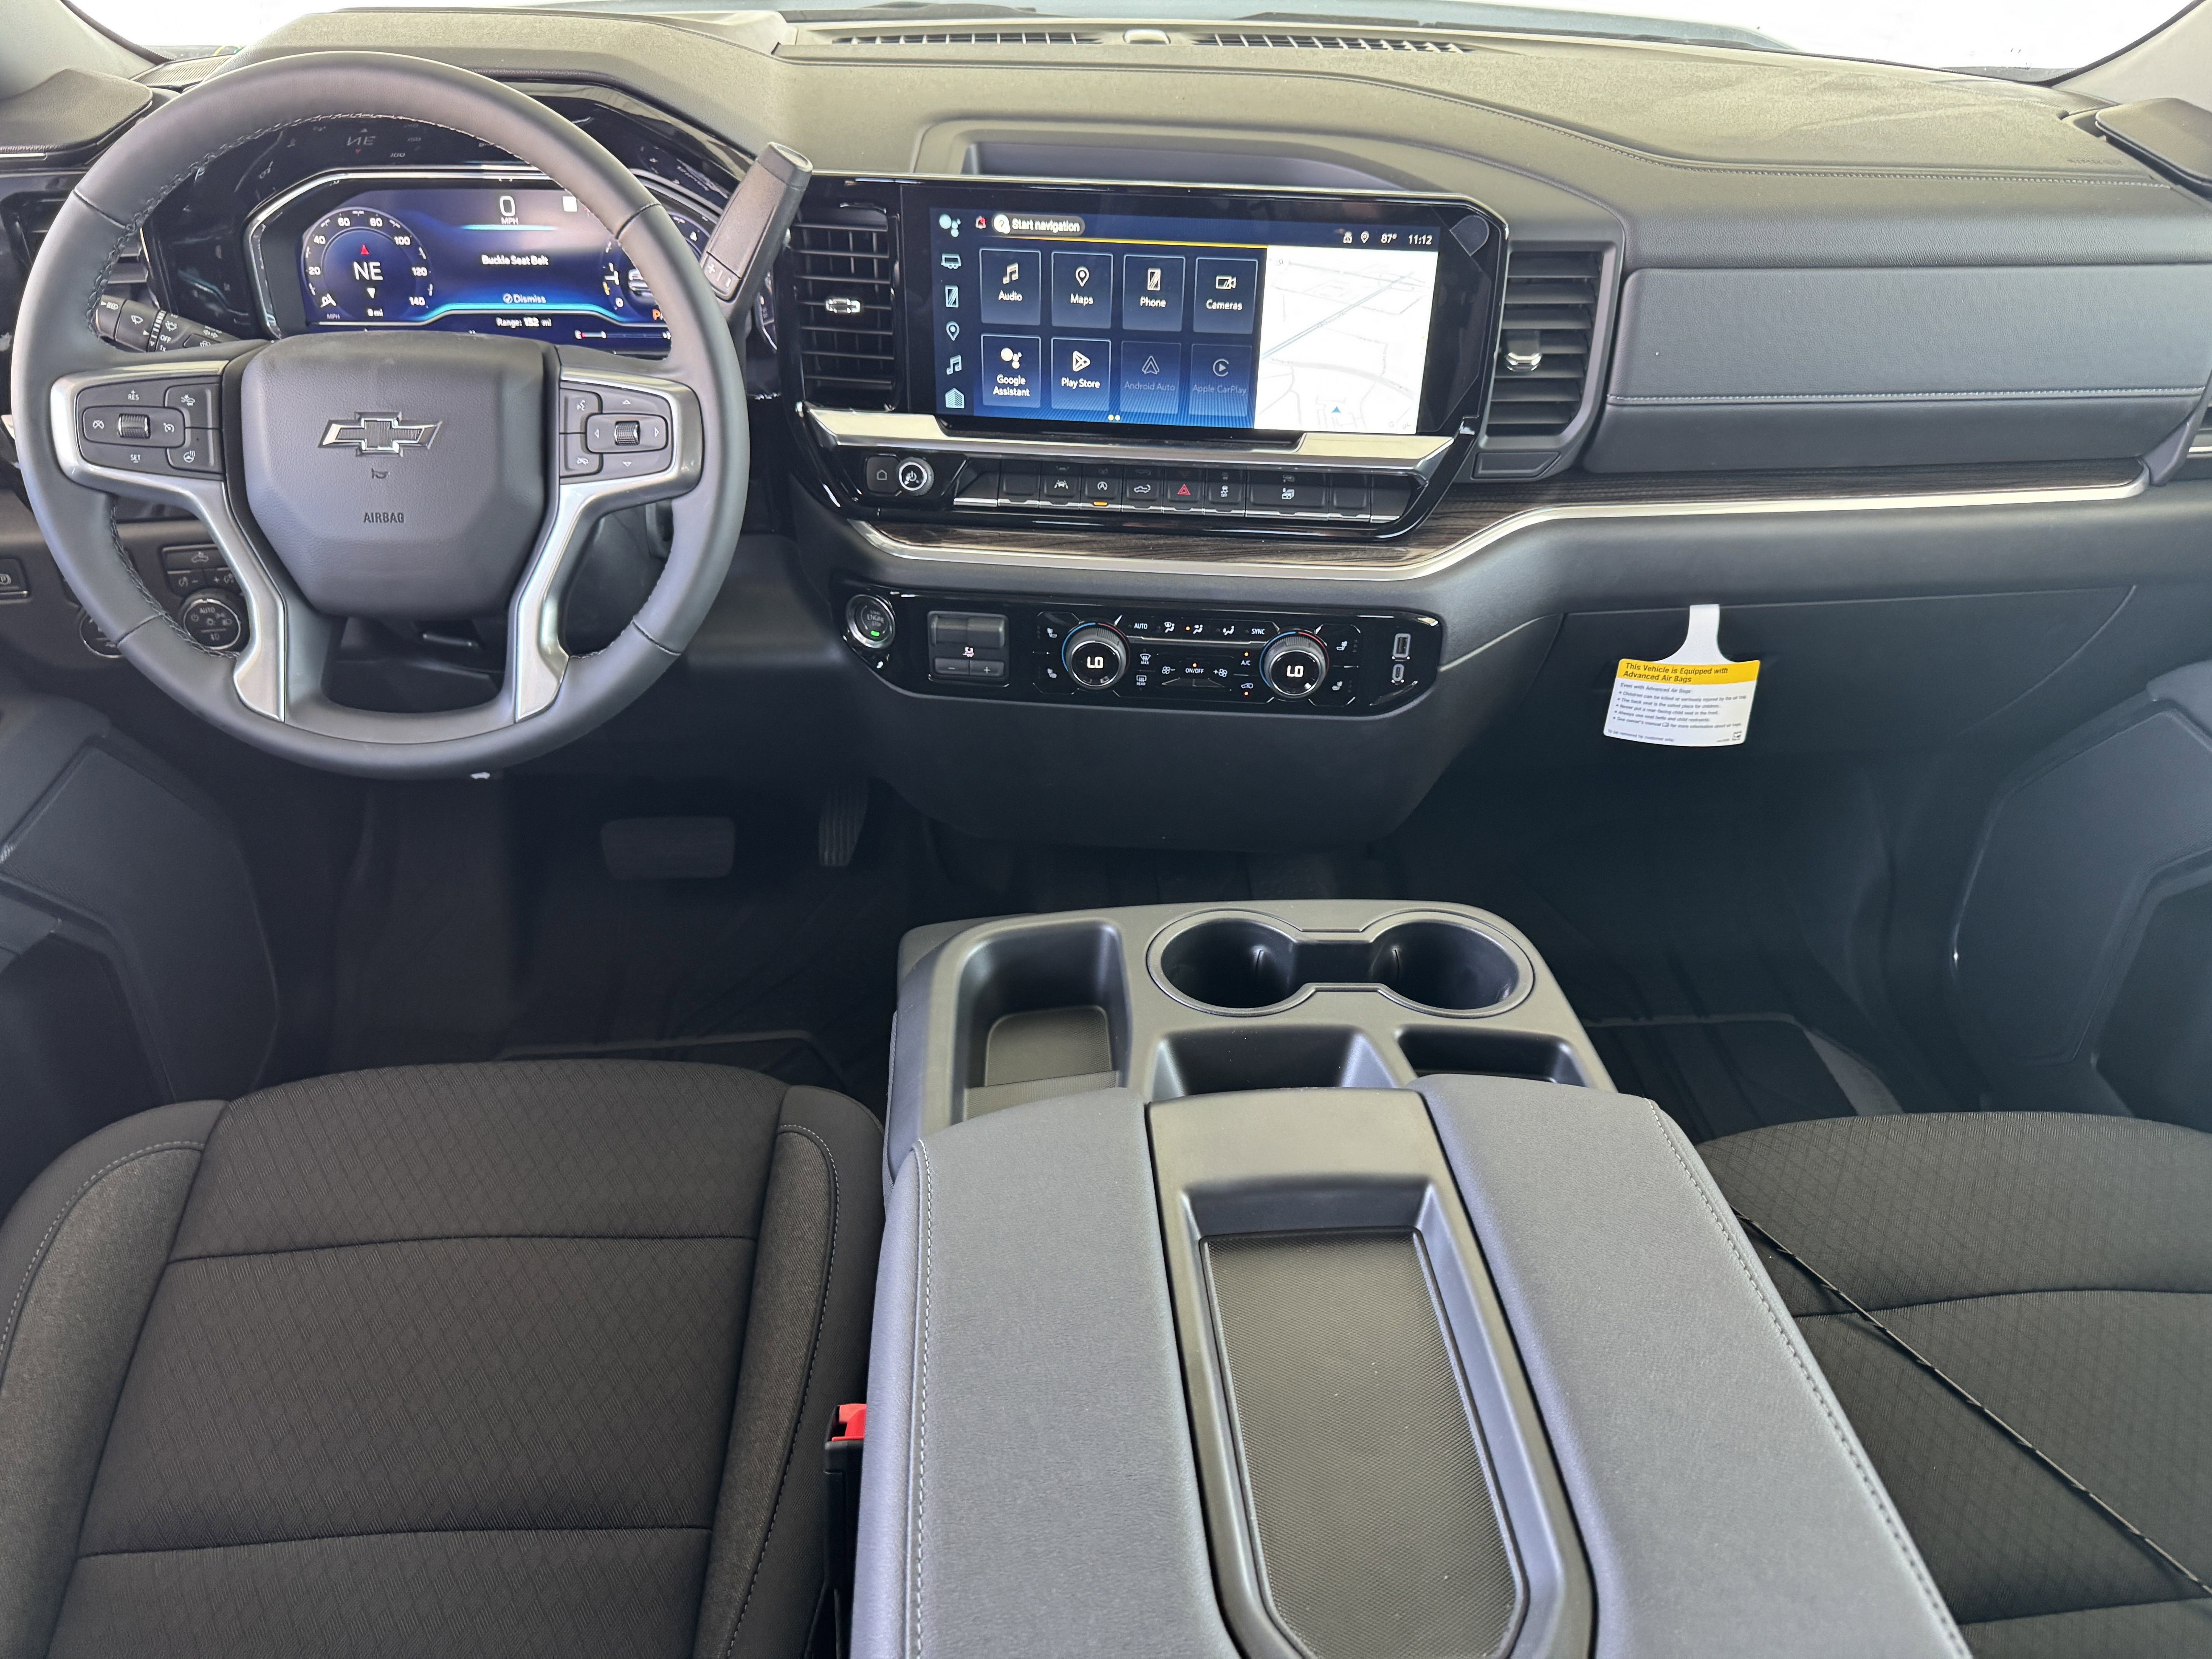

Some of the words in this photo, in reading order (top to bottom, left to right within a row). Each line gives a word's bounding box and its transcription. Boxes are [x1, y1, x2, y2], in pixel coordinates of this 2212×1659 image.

[500, 195, 516, 217] 0
[338, 217, 350, 227] 60
[370, 218, 383, 227] 80
[1012, 218, 1034, 230] Start
[1035, 219, 1080, 233] navigation
[314, 235, 326, 245] 40
[394, 236, 410, 245] 100
[1381, 233, 1397, 243] 87°
[1408, 234, 1432, 245] 11:12
[481, 254, 510, 264] Buckle
[510, 255, 531, 265] Seat
[531, 254, 549, 265] Belt
[309, 266, 321, 275] 20
[354, 262, 383, 280] NE
[412, 267, 427, 276] 120
[409, 296, 425, 306] 140
[513, 294, 546, 304] Dismiss
[998, 290, 1023, 302] Audio
[1070, 294, 1093, 306] Maps
[1140, 297, 1166, 307] Phone
[1206, 299, 1243, 311] Cameras
[374, 308, 383, 316] mi
[496, 317, 522, 328] Range:
[541, 318, 551, 326] mi
[160, 334, 171, 343] OFF
[997, 375, 1026, 386] Google
[1061, 378, 1077, 389] Play
[1079, 379, 1100, 389] Store
[993, 386, 1030, 397] Assistant
[1125, 382, 1154, 391] Android
[1156, 383, 1175, 392] Auto
[1193, 385, 1216, 395] Apple
[1217, 385, 1247, 396] CarPlay
[363, 512, 405, 524] AIRBAG
[1087, 656, 1104, 669] LO
[1286, 665, 1304, 678] LO
[1623, 671, 1659, 680] Advanced
[1644, 665, 1669, 673] Vehicle
[1680, 668, 1712, 676] Equipped
